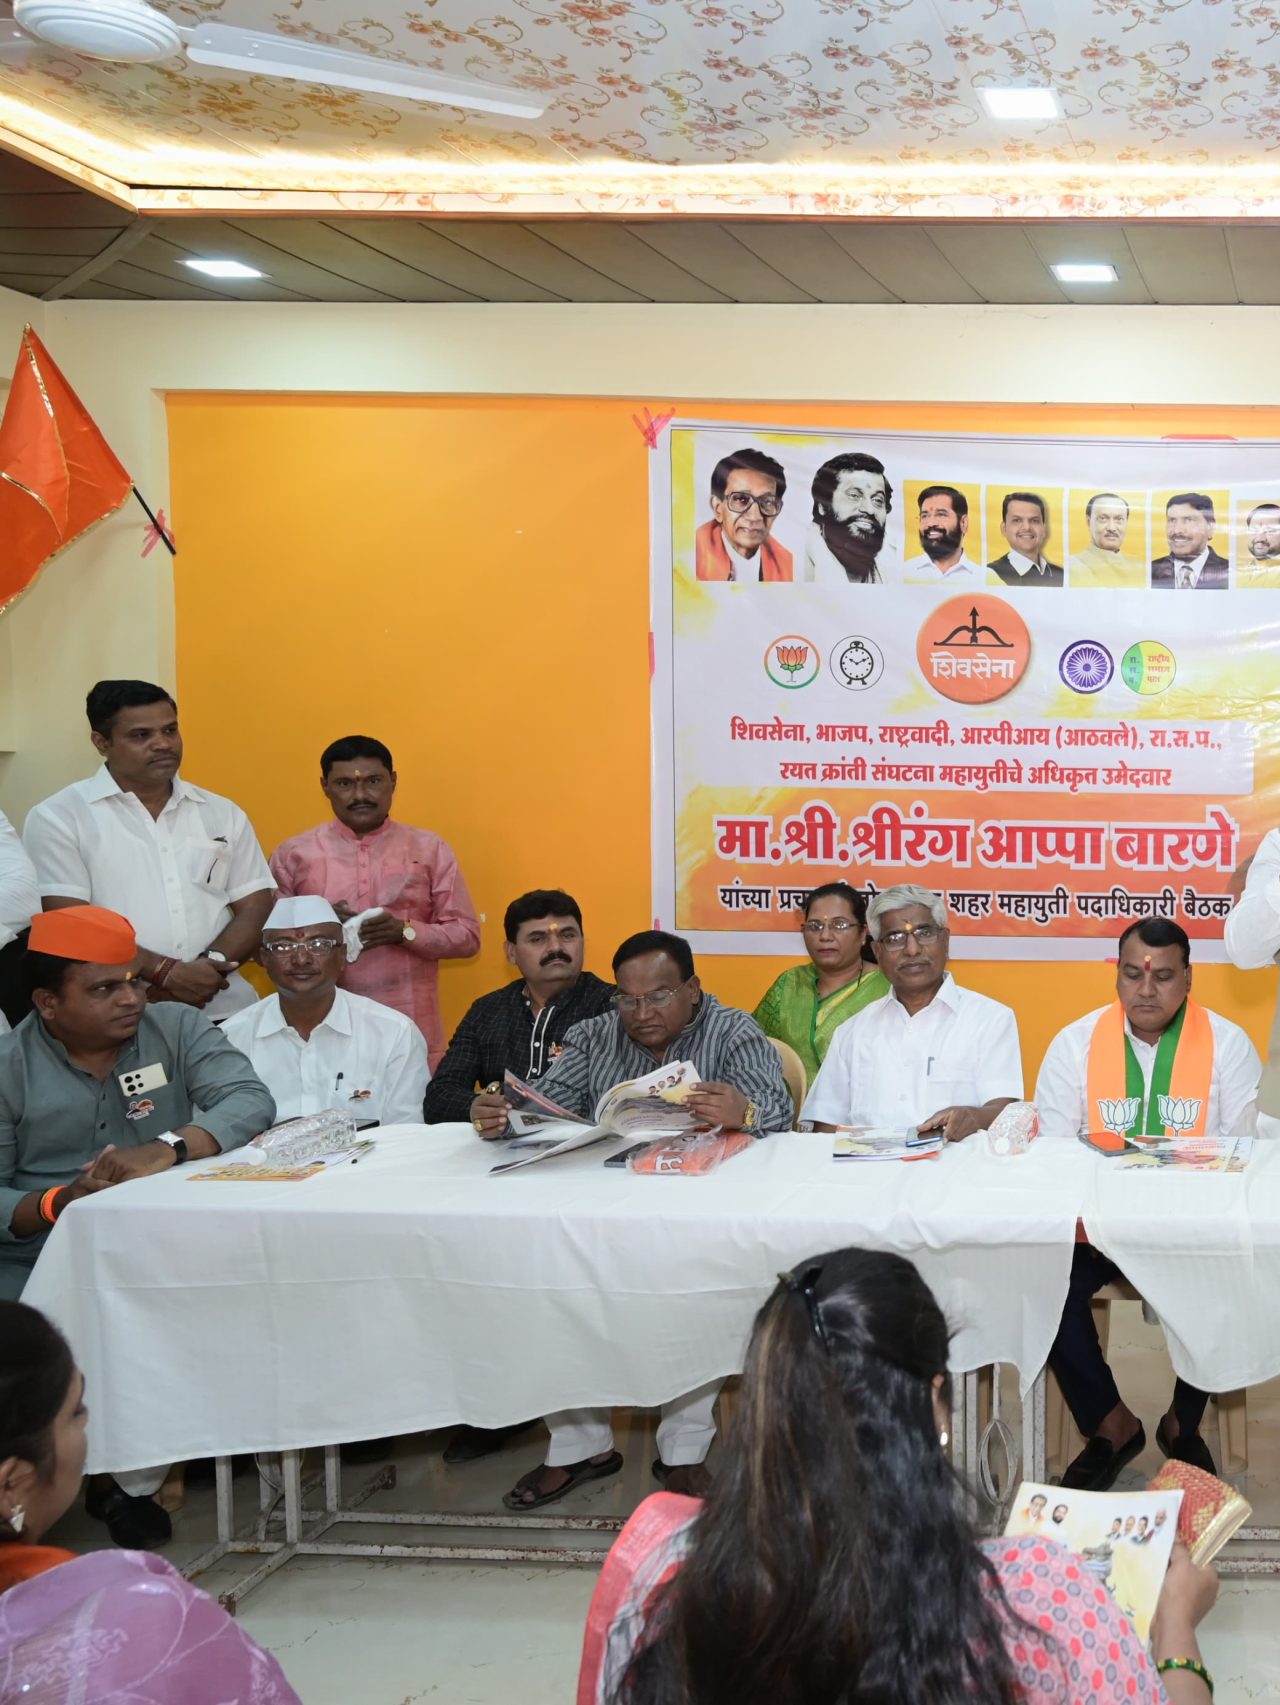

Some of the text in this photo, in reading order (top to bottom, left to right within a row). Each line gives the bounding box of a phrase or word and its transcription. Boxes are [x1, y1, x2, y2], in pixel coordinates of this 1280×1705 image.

[929, 651, 1016, 679] शिवसेना
[730, 715, 811, 744] शिवसेना,
[816, 724, 873, 745] भाजप,
[878, 719, 955, 748] राष्ट्रवादी,
[960, 720, 1051, 748] आरपीआय
[1055, 722, 1145, 751] (आठवले),
[780, 756, 1172, 792] रयत क्रांती संघटना महायुतीचे अधिकृत उमेदवार
[981, 825, 1105, 865] आप्पा
[1114, 811, 1235, 867] बारणे
[720, 880, 771, 909] यांच्या
[949, 892, 991, 917] शहर
[998, 886, 1069, 923] महायुती
[1076, 888, 1176, 917] पदाधिकारी
[1183, 888, 1232, 917] बैठक
